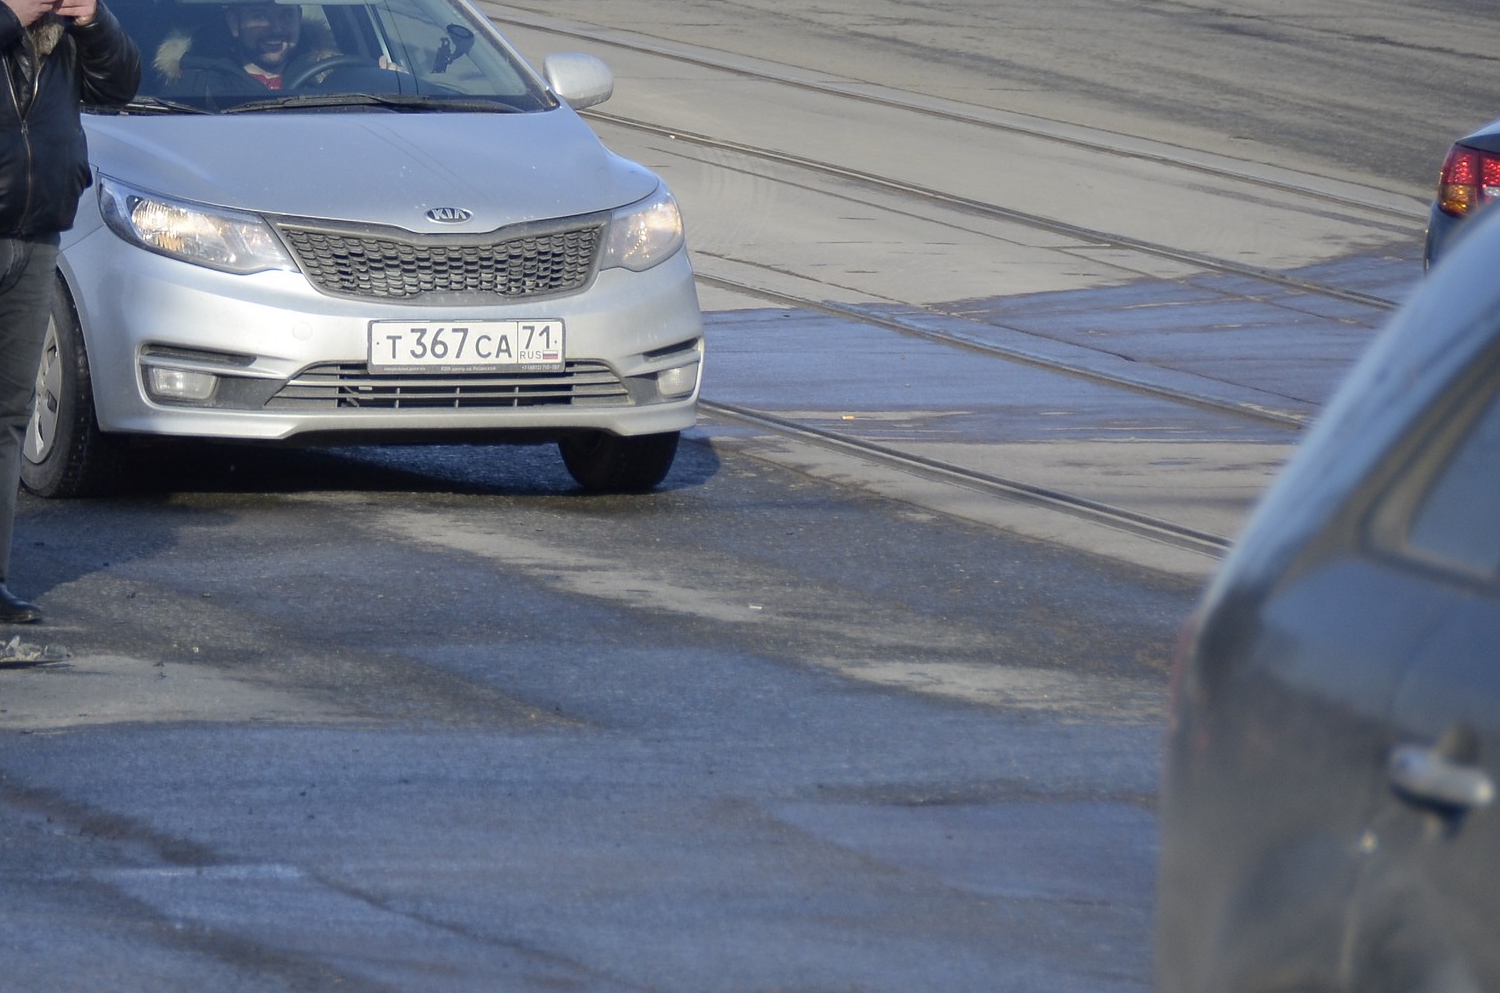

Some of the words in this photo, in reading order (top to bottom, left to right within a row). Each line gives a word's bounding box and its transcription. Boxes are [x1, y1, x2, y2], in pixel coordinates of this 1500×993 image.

[431, 208, 467, 220] KIA
[386, 327, 513, 359] Т367СА
[521, 325, 551, 349] 71
[519, 350, 542, 360] RUS
